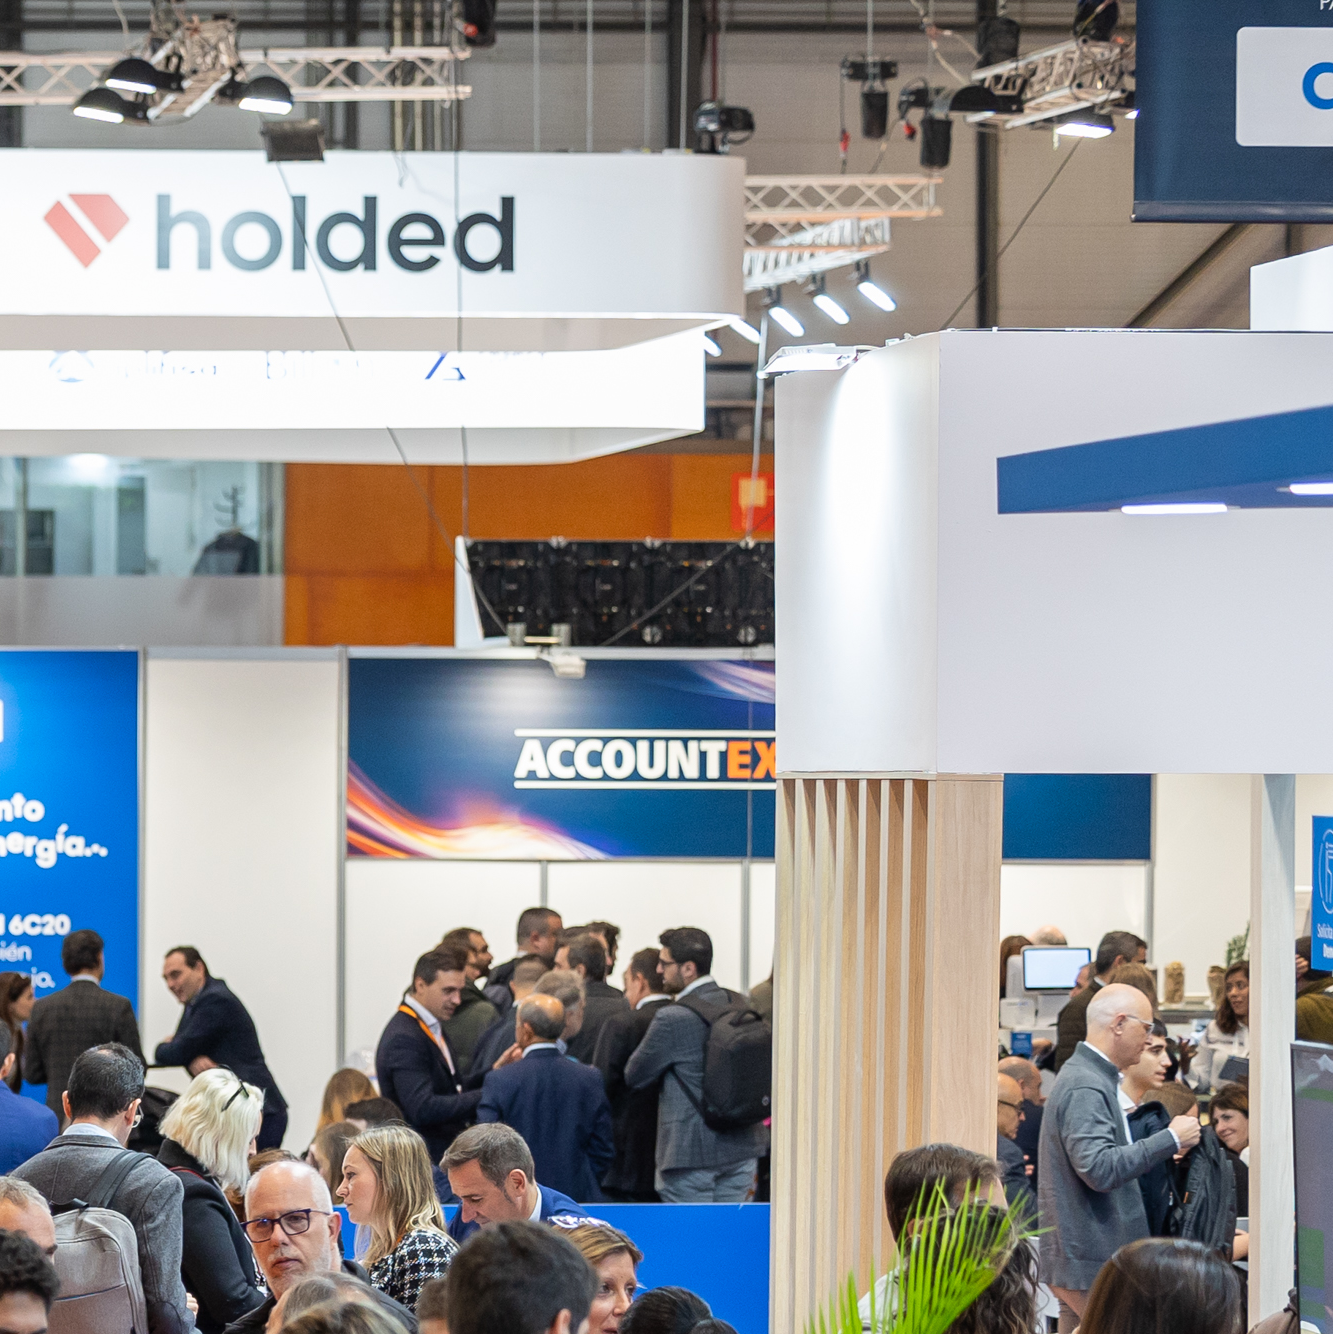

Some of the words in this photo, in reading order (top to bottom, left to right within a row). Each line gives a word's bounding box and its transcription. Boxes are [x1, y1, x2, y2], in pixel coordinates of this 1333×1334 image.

[156, 193, 515, 273] holded
[513, 738, 776, 780] ACCOUNTEX
[7, 913, 72, 936] 6C20
